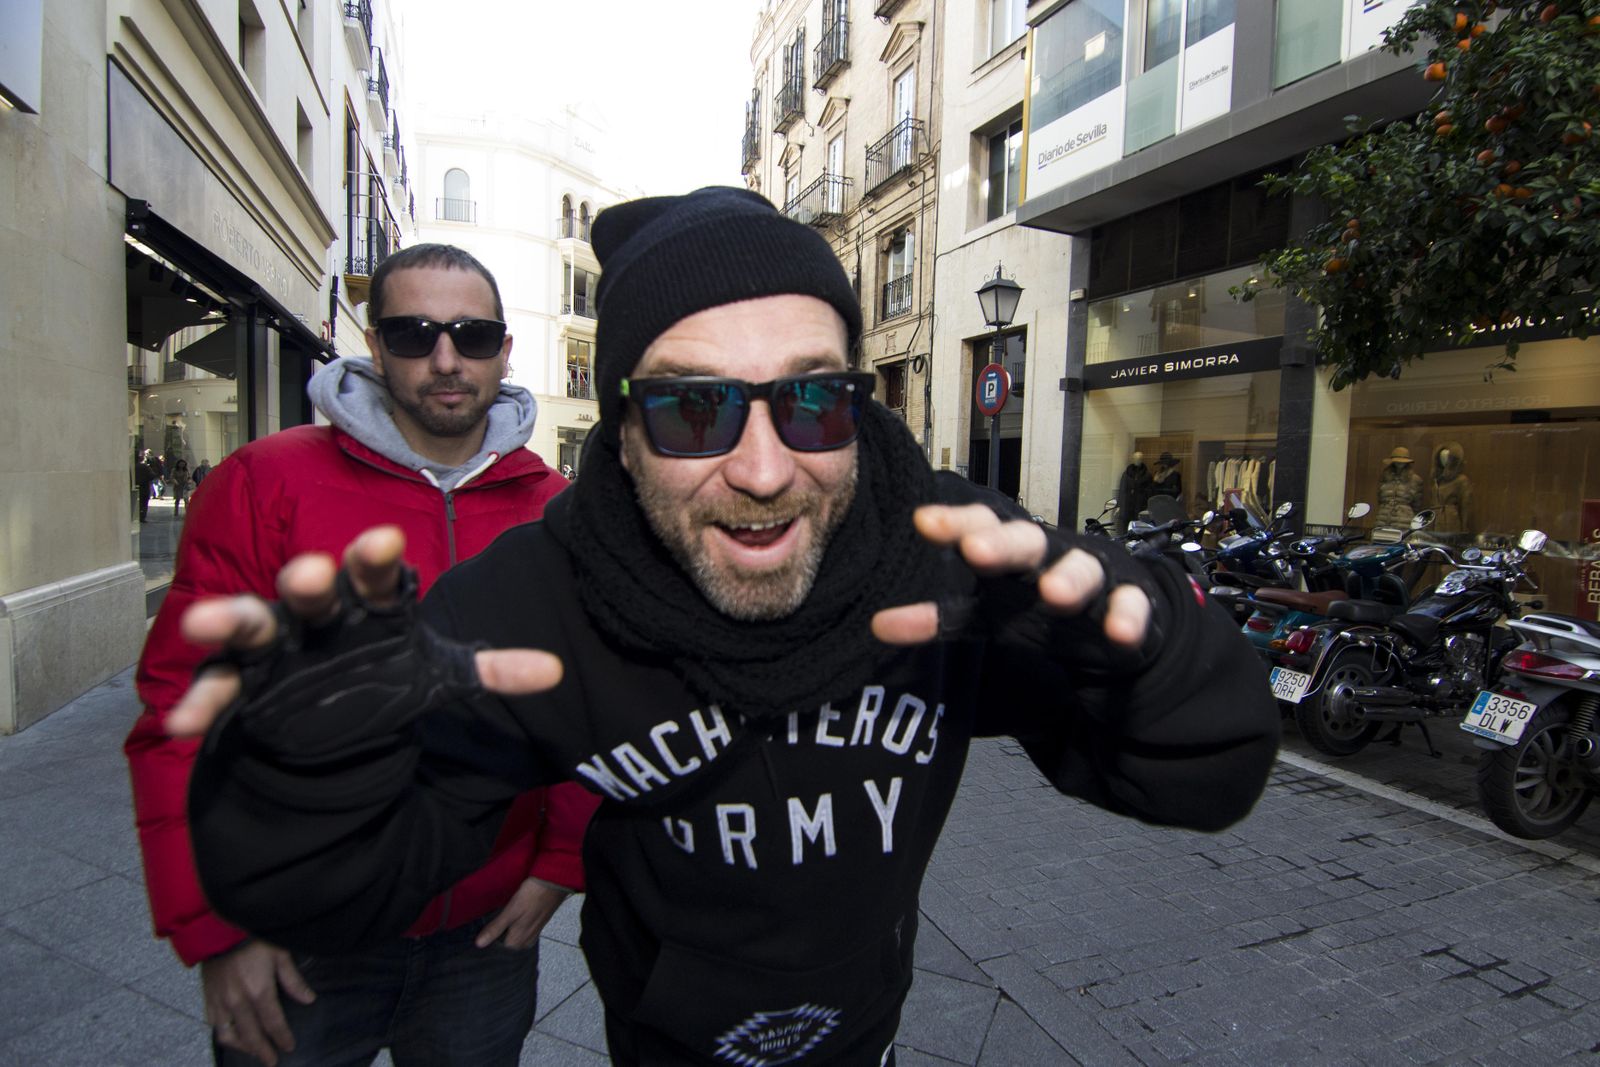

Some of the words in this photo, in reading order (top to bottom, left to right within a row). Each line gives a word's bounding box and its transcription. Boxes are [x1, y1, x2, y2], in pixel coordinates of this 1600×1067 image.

[1038, 144, 1064, 165] Diario
[1064, 138, 1075, 153] de
[1076, 123, 1107, 147] Sevilla
[212, 212, 260, 270] ROBERTO
[1110, 364, 1159, 379] JAVIER
[1164, 353, 1240, 372] SIMORRA
[987, 382, 995, 397] P
[1278, 670, 1307, 687] 9250
[1274, 682, 1296, 698] DRH
[1488, 696, 1531, 719] 3356
[1478, 713, 1513, 733] DLW
